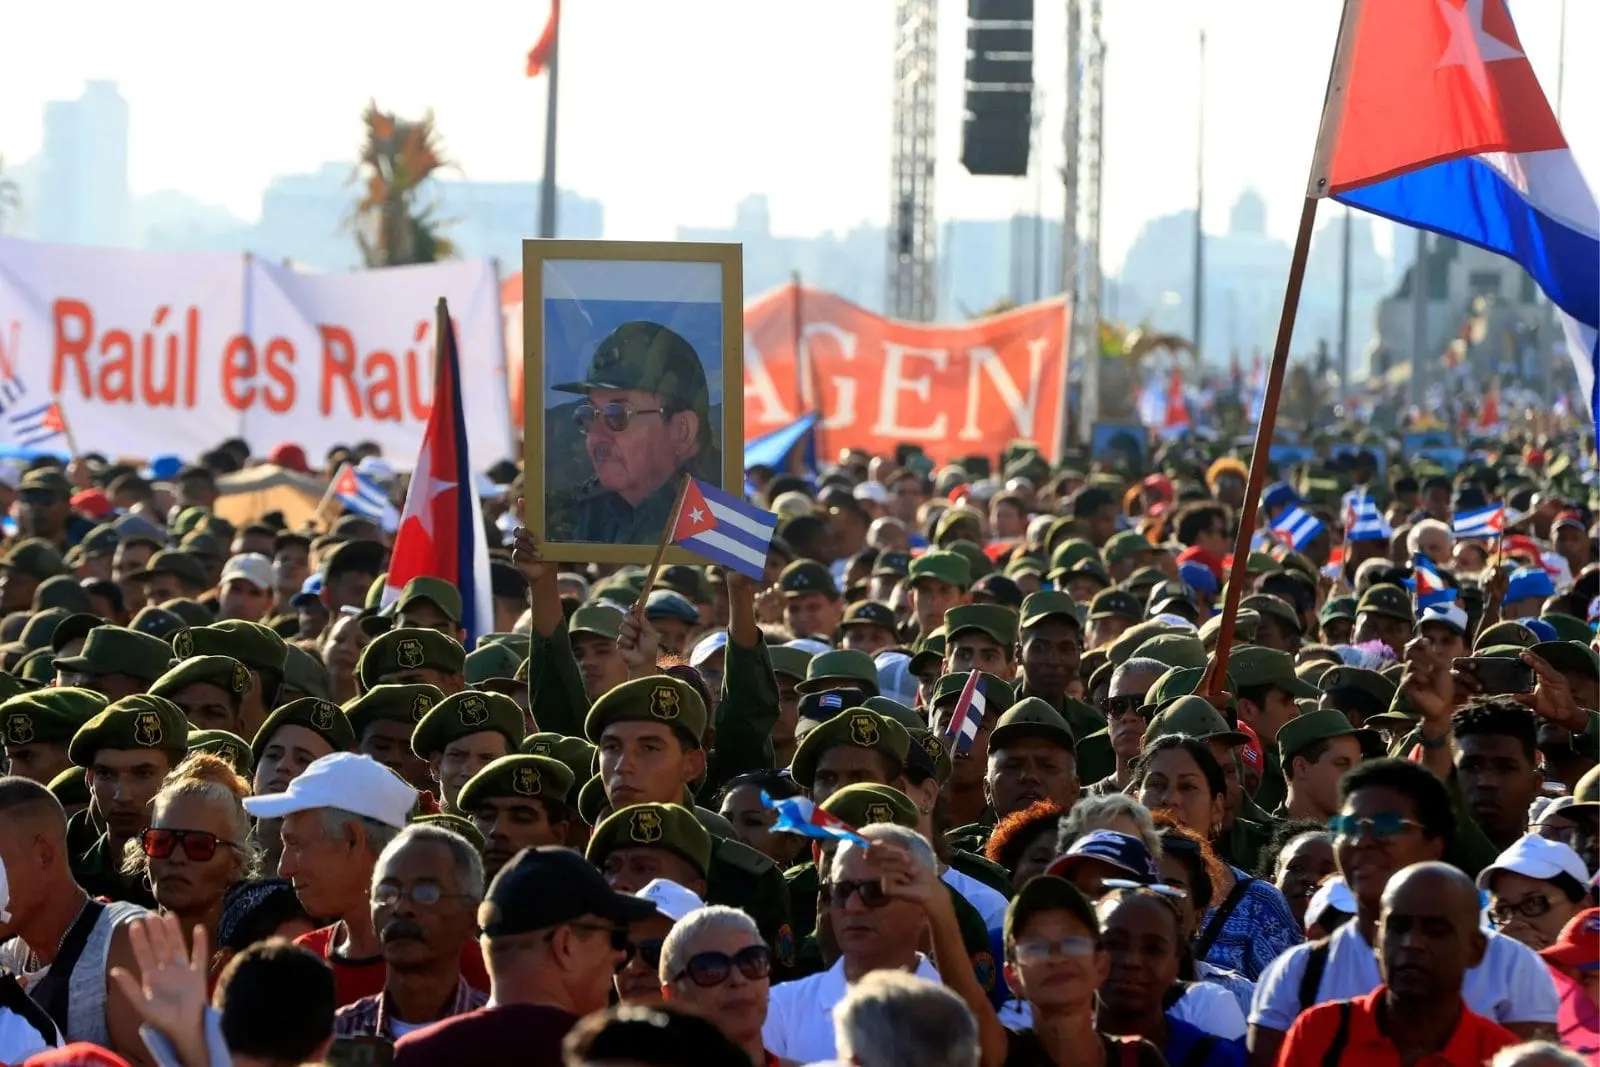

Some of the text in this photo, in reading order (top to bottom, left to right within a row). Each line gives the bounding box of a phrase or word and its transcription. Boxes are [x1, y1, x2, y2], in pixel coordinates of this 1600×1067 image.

[52, 298, 201, 409] Raúl
[221, 334, 297, 413] es
[317, 316, 460, 422] Raú
